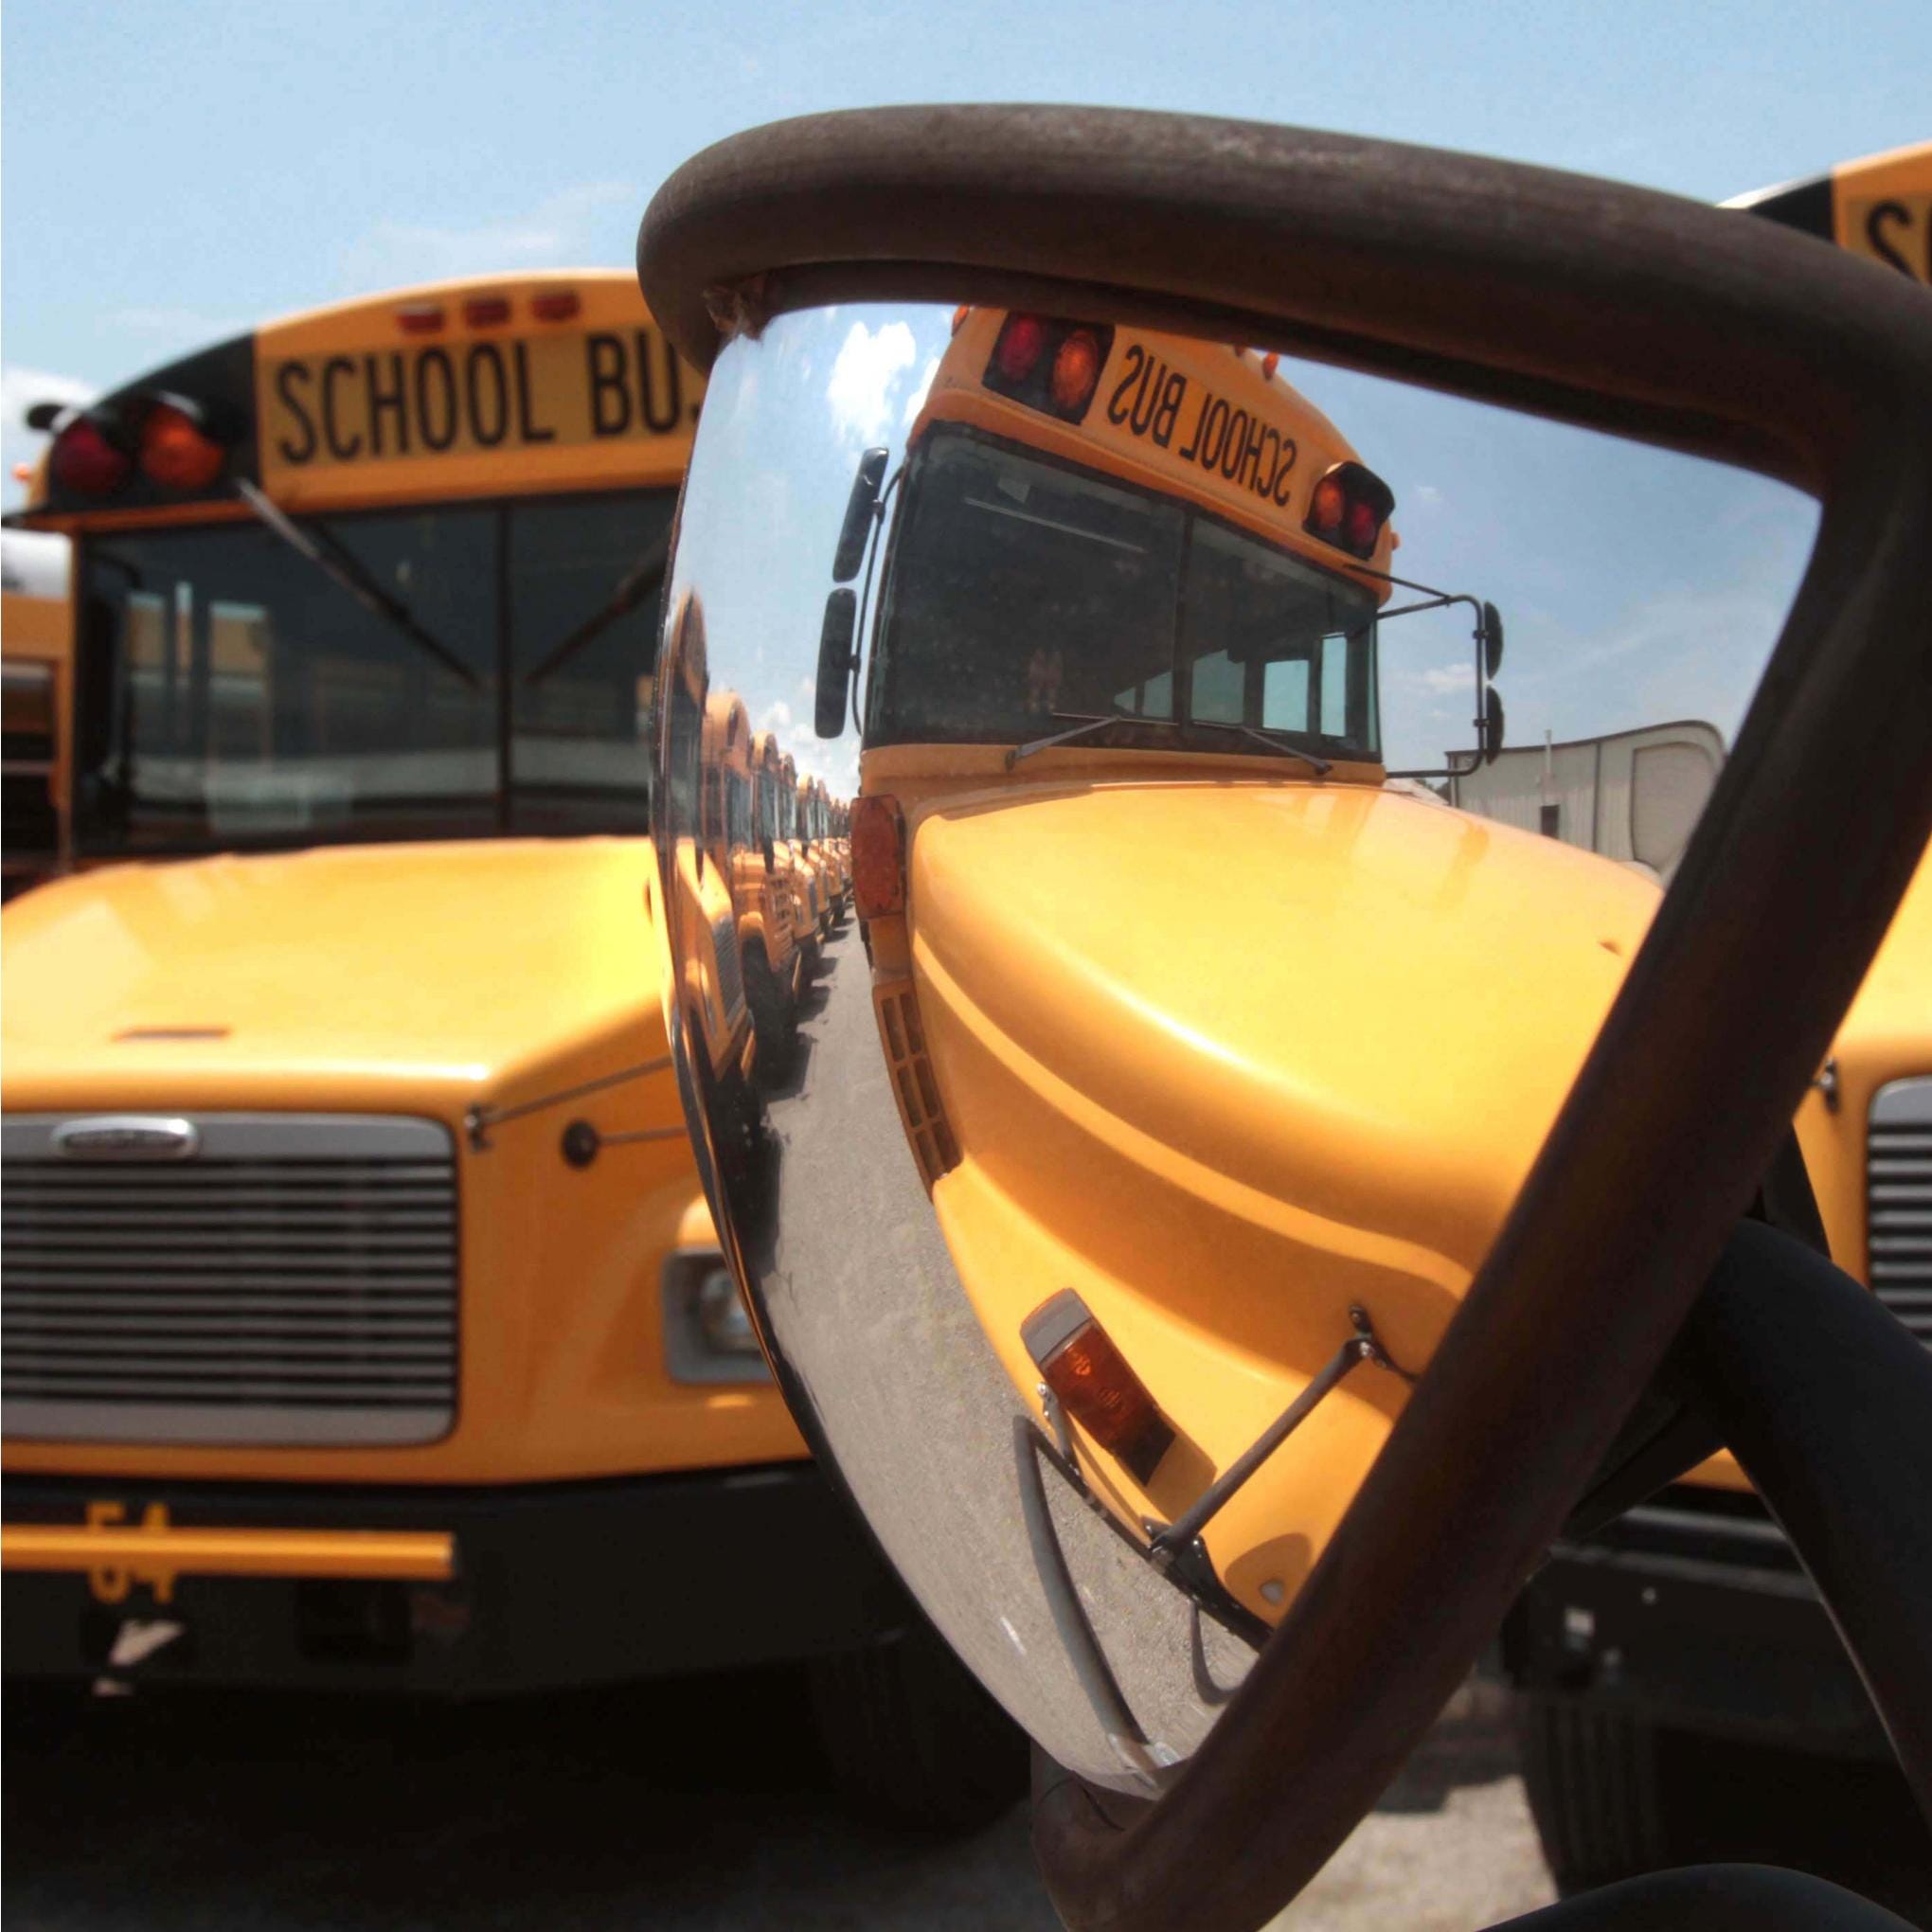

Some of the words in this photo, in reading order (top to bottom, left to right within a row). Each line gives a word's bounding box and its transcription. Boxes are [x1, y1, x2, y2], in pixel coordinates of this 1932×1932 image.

[1866, 201, 1932, 286] S
[277, 341, 555, 464] SCHOOL
[587, 332, 701, 437] BU
